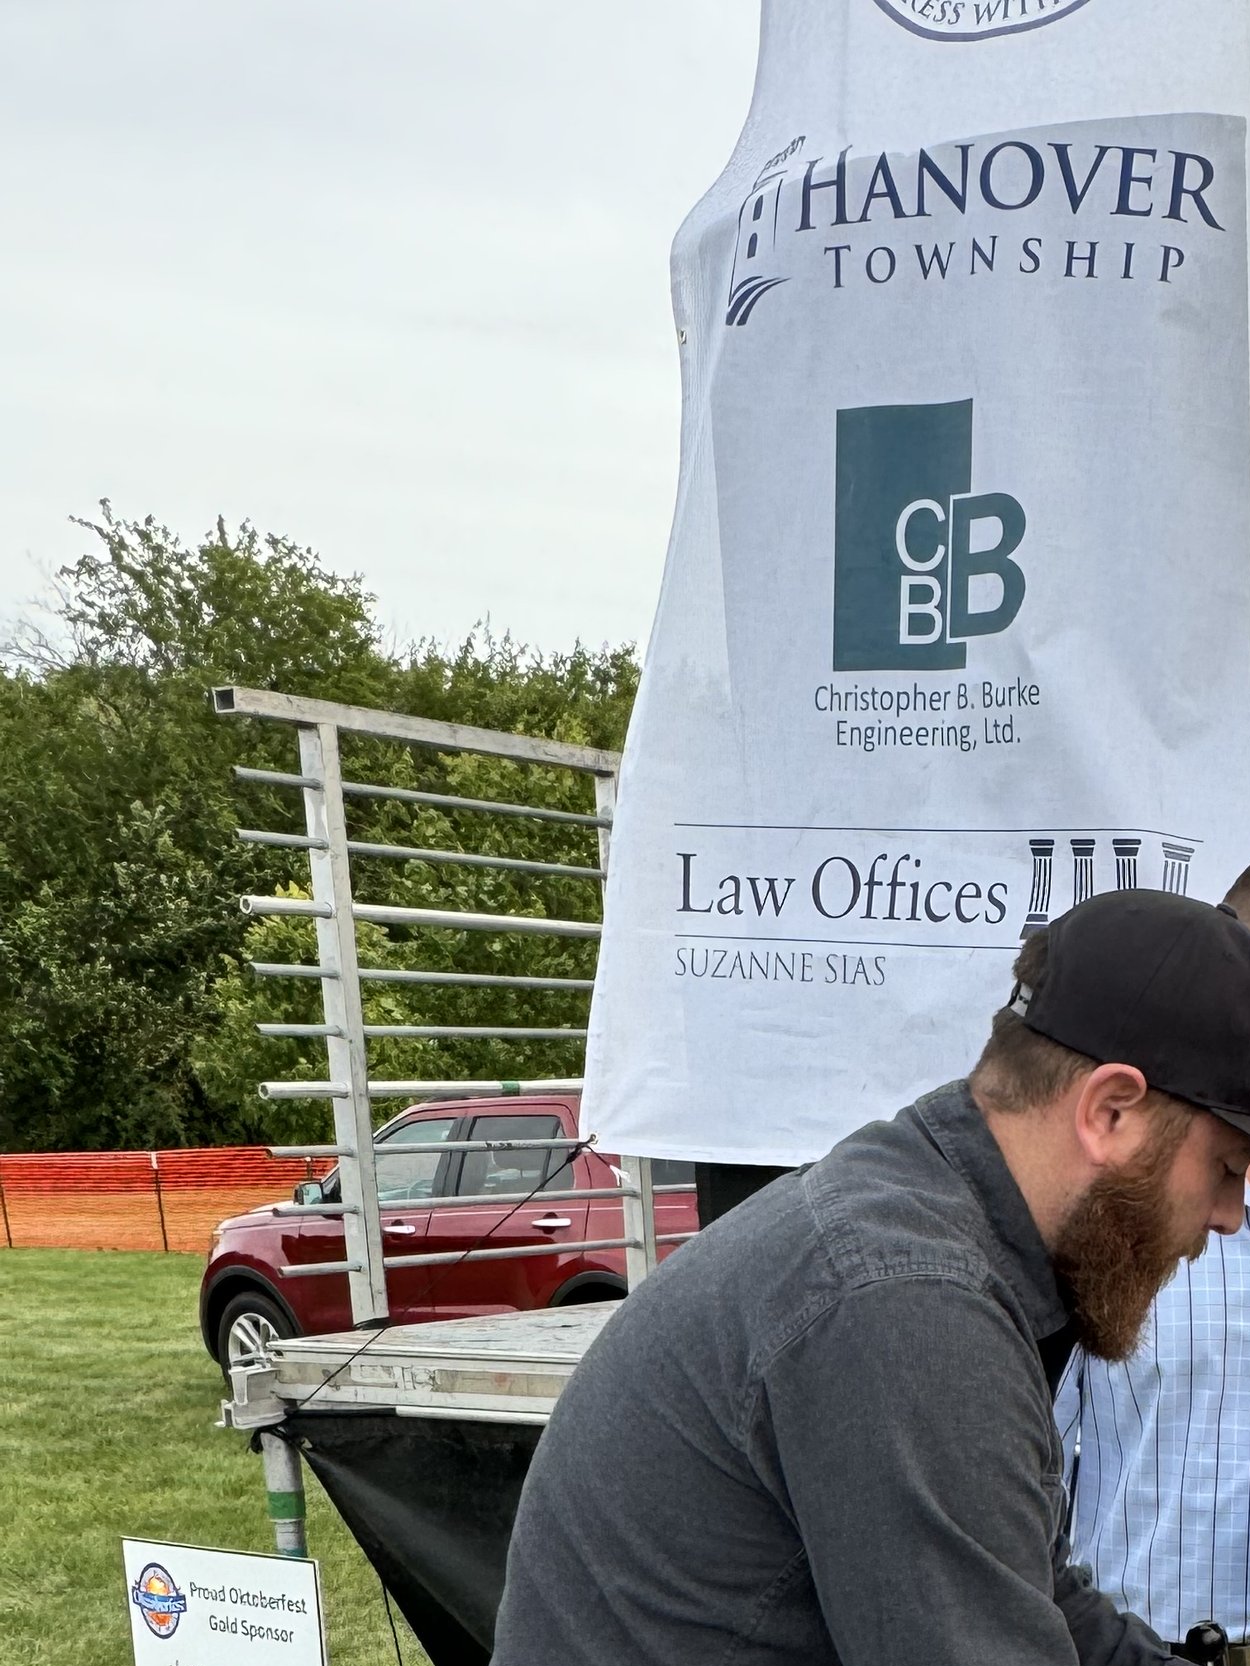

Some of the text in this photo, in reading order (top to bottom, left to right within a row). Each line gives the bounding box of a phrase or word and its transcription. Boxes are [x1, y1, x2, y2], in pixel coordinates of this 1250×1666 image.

[795, 140, 1226, 232] HANOVER
[823, 235, 1186, 289] TOWNSHIP
[814, 676, 1041, 718] Christopher B. Burke
[836, 714, 1021, 752] Engineering, Ltd.
[676, 852, 1009, 925] Law Offices
[674, 948, 887, 986] SUZANNE SIAS
[189, 1581, 226, 1602] Proud
[208, 1614, 294, 1643] Gold Sponsor
